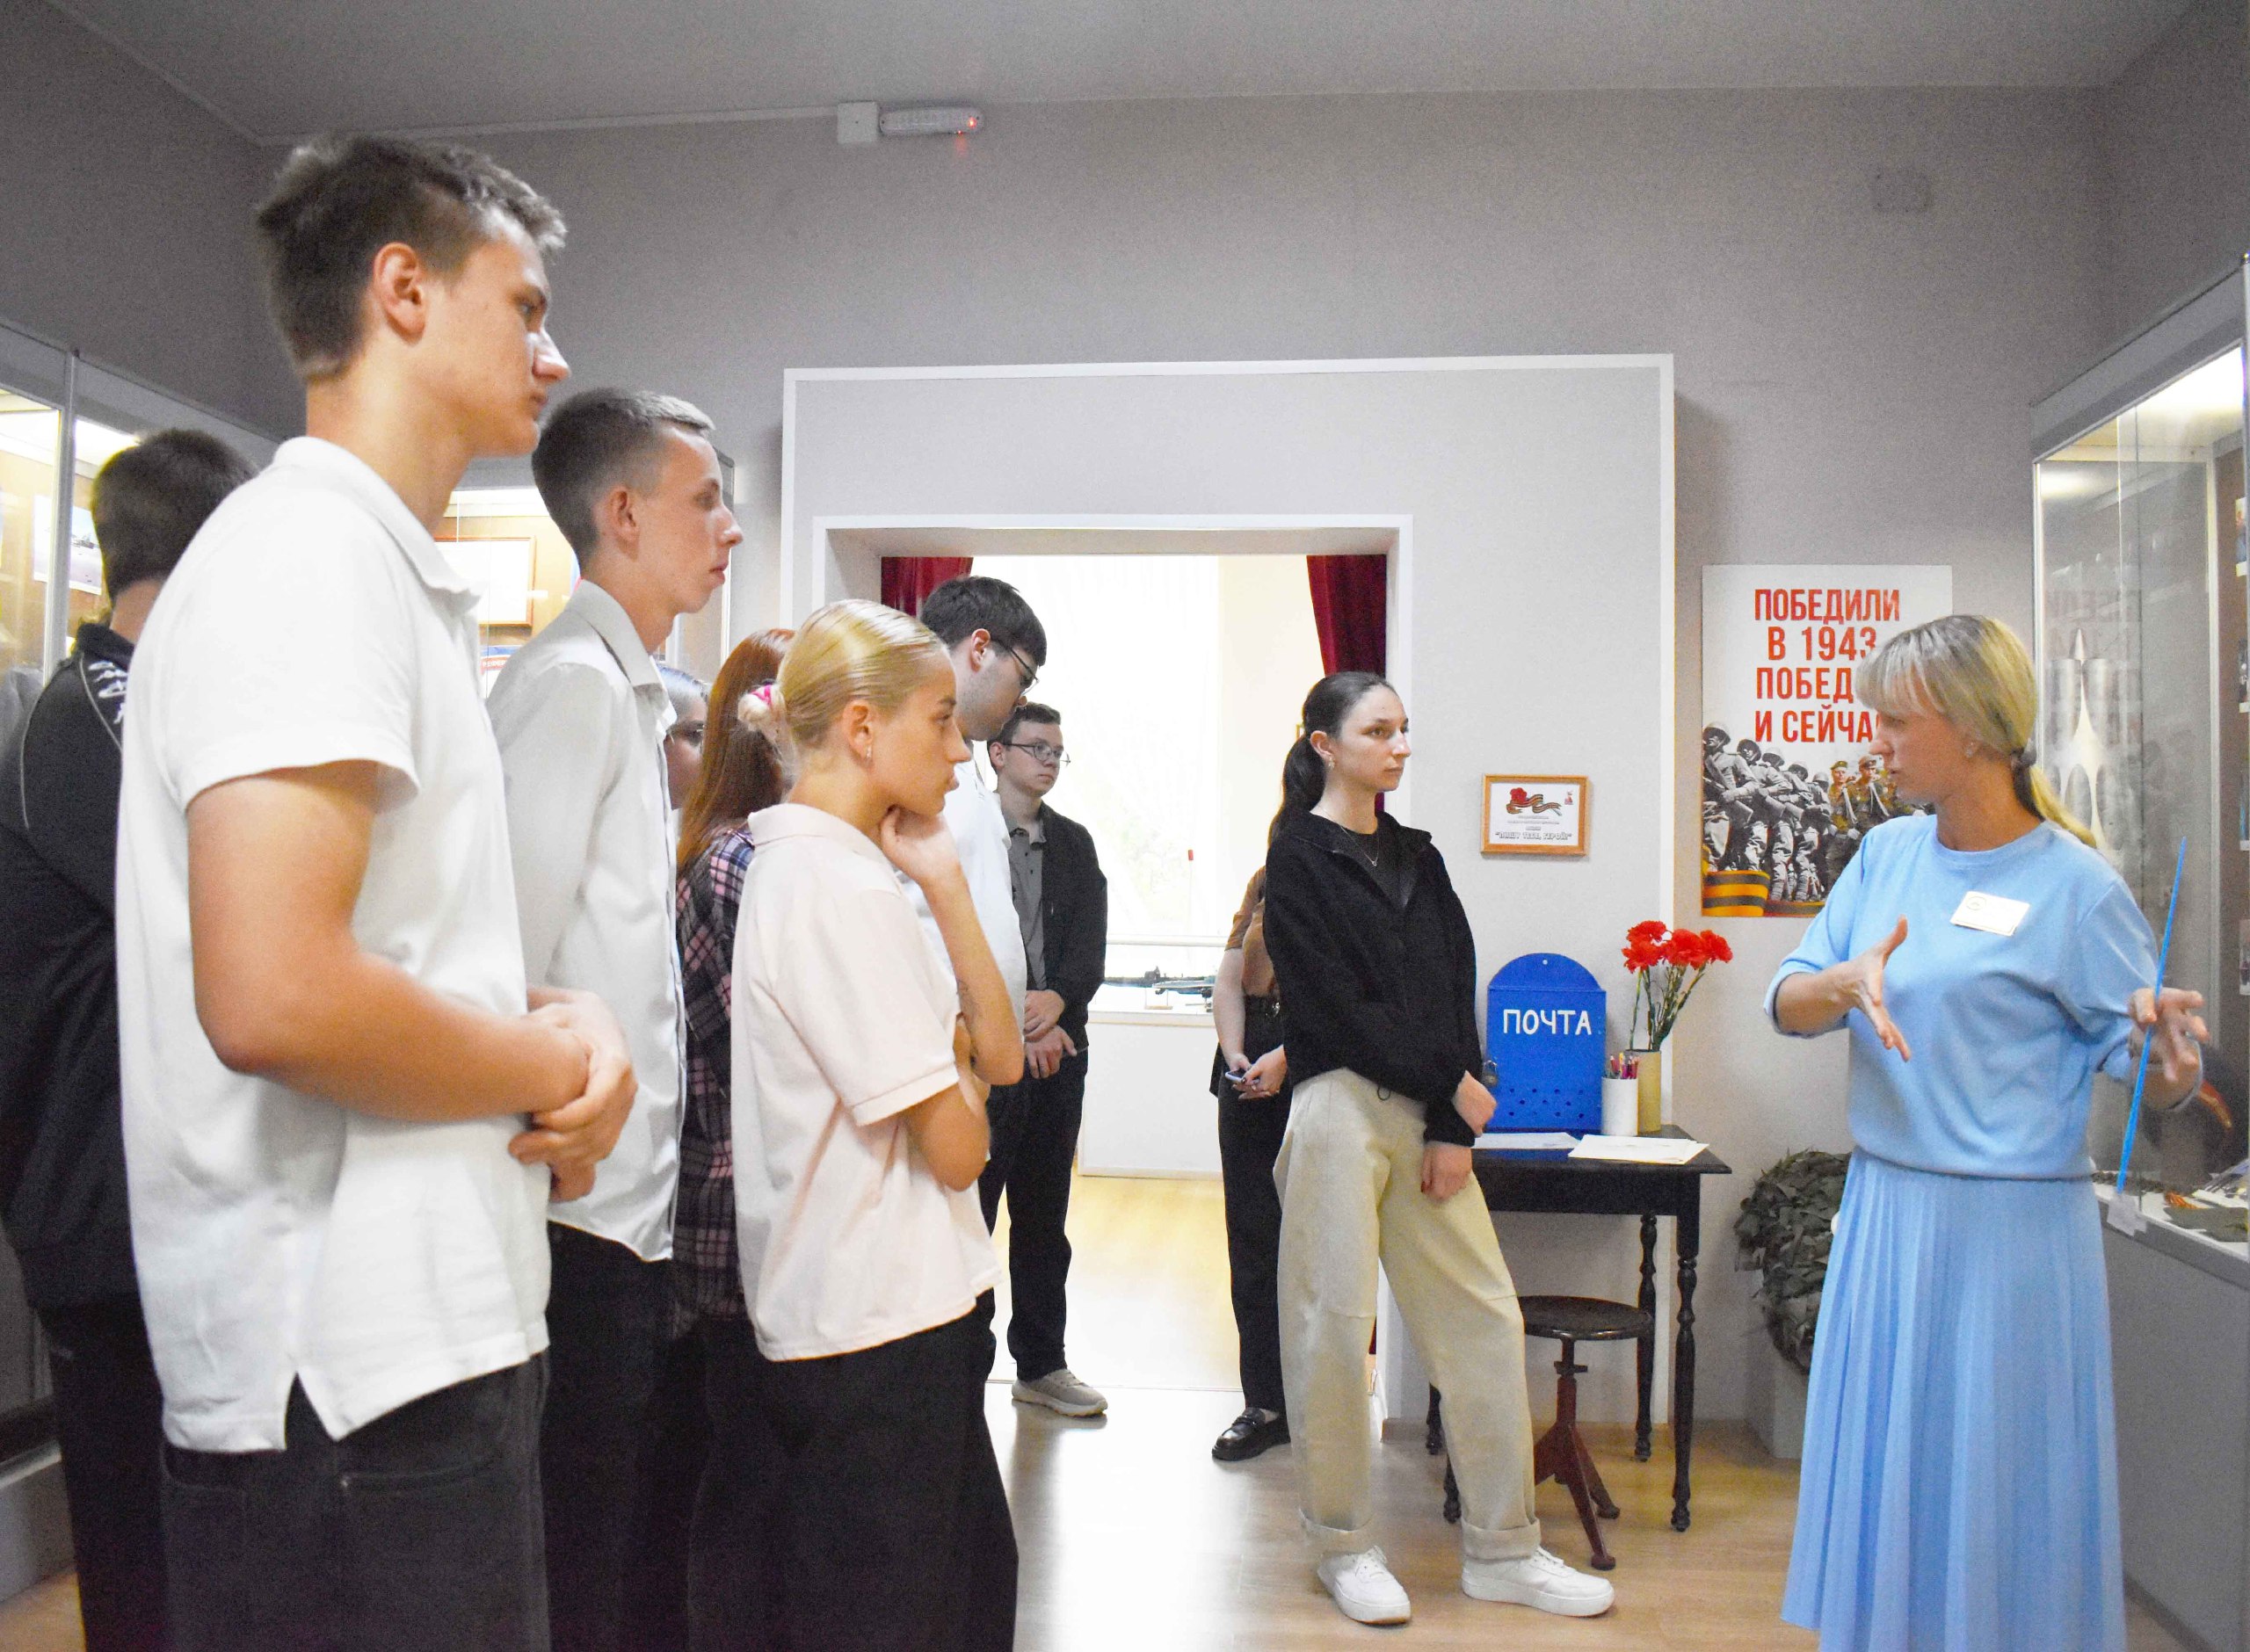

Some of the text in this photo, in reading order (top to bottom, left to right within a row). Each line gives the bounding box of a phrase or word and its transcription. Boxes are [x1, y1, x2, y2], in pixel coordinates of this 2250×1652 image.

[1755, 589, 1900, 625] ПОБЕДИЛИ
[1767, 626, 1876, 661] В 1943
[1756, 667, 1854, 704] ПОБЕД
[1755, 704, 1880, 743] И СЕЙЧА
[1503, 1009, 1593, 1035] ПОЧТА
